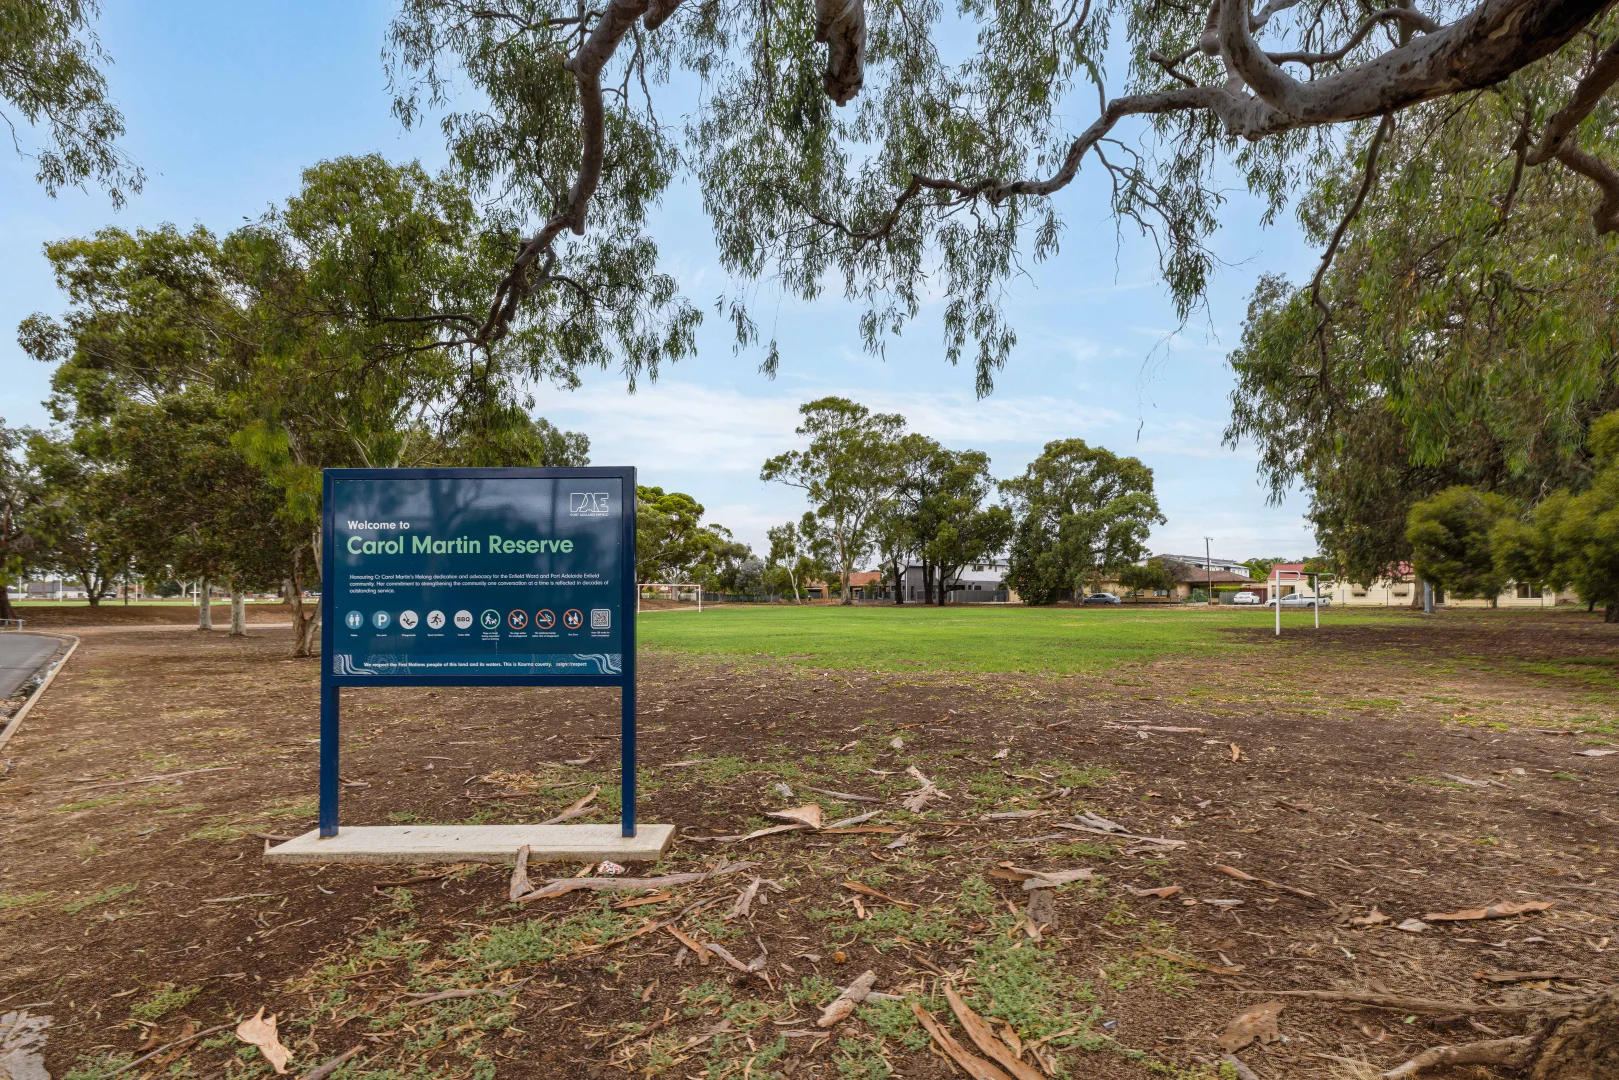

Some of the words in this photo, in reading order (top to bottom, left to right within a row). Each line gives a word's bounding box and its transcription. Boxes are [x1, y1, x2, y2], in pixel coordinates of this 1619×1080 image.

[570, 493, 609, 512] PAE
[348, 520, 396, 530] Welcome
[399, 521, 410, 530] to
[347, 536, 404, 554] Carol
[412, 536, 480, 554] Martin
[489, 535, 574, 554] Reserve
[378, 614, 387, 626] P
